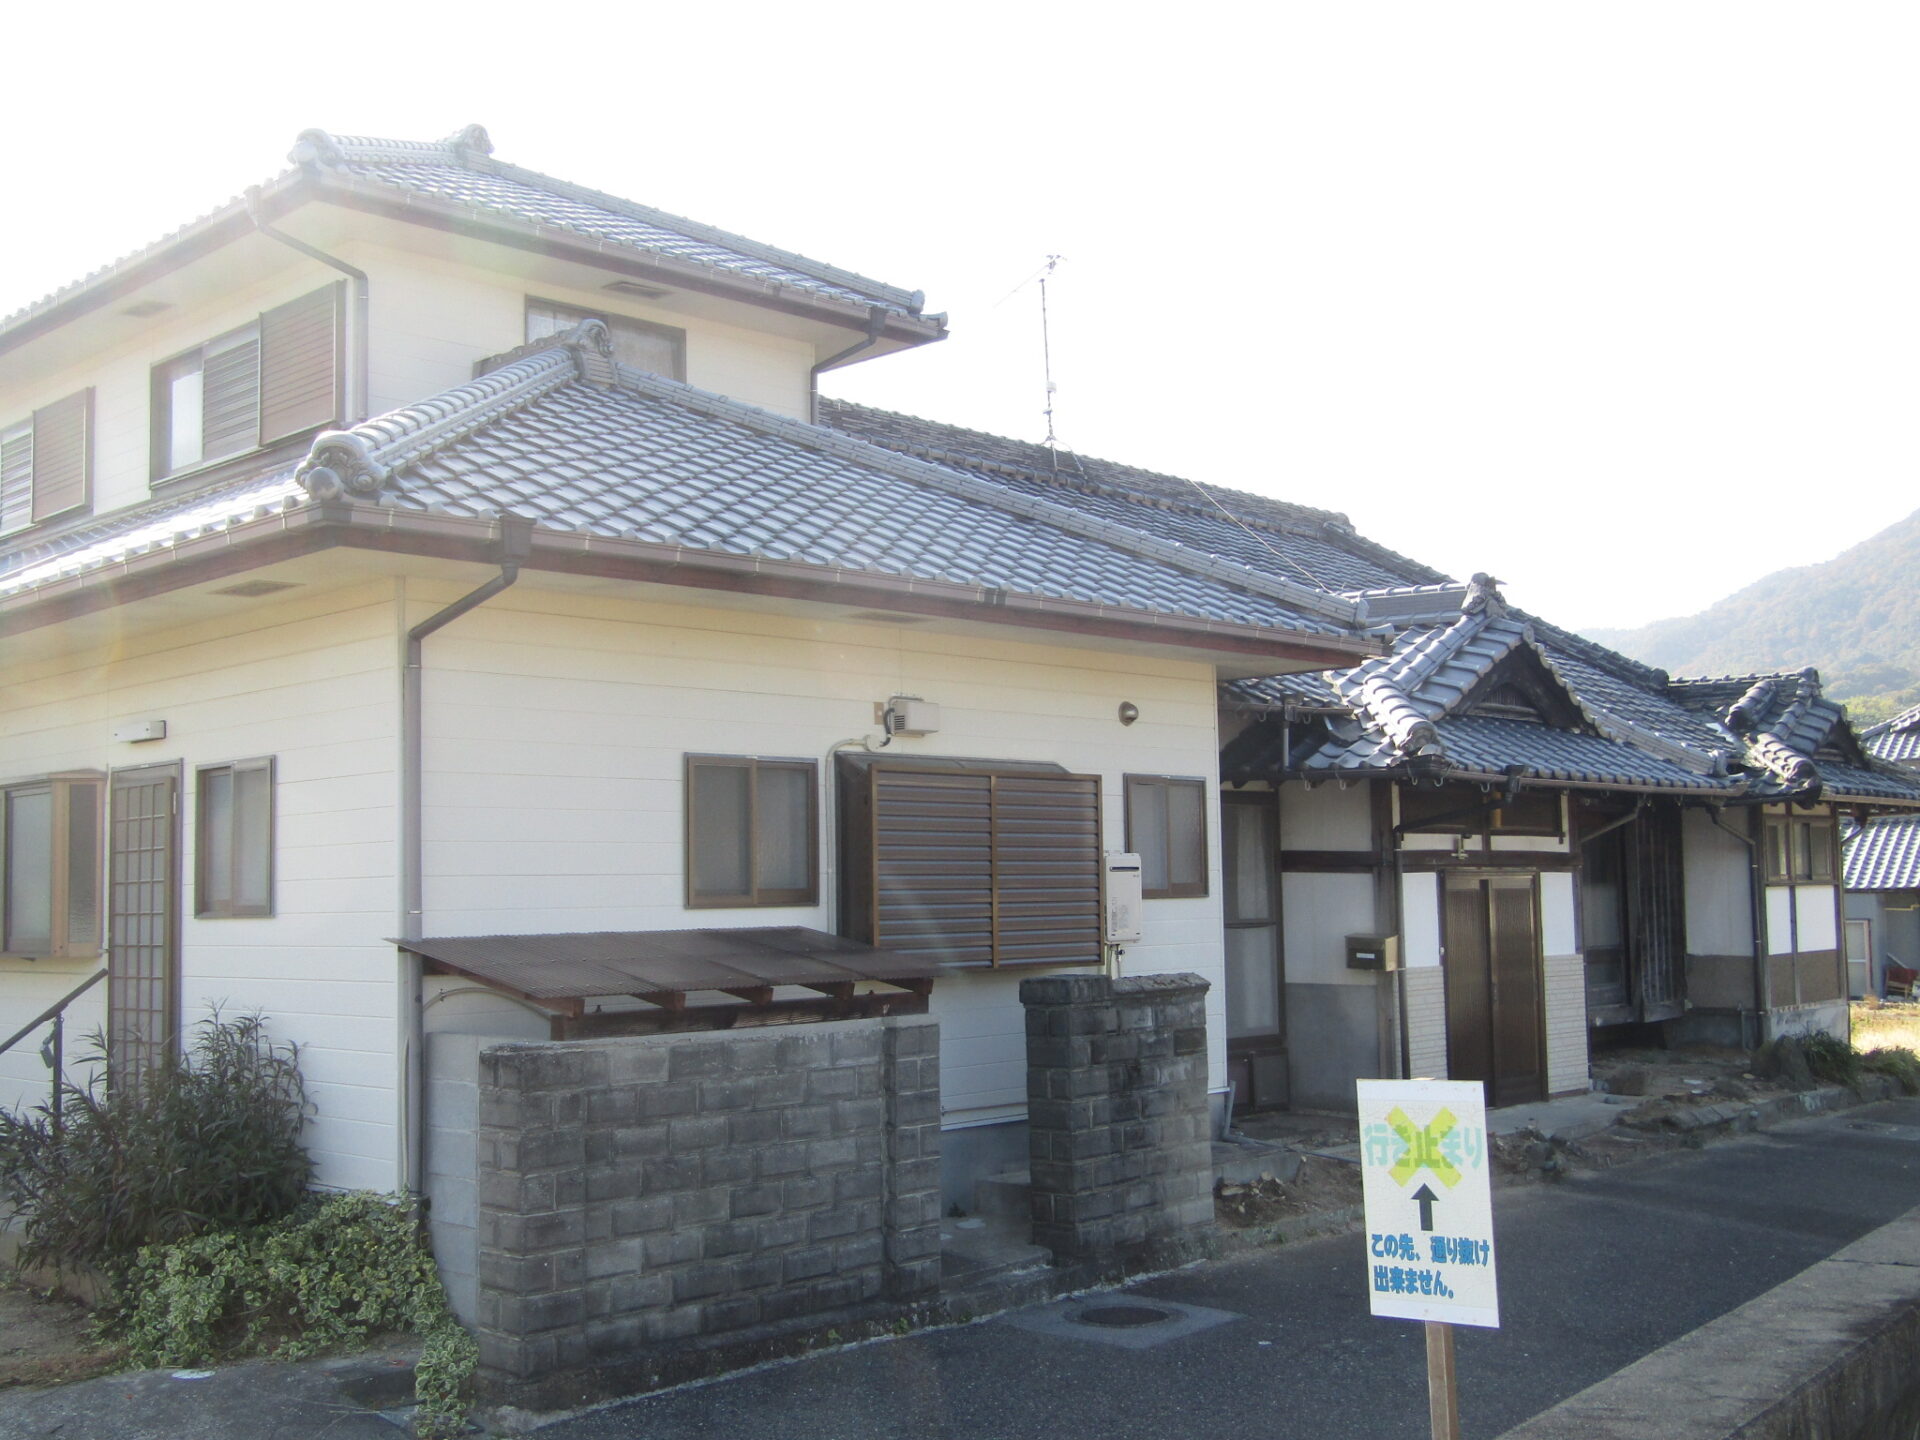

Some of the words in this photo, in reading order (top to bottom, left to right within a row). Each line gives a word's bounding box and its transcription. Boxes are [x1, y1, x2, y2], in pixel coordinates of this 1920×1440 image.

[1364, 1123, 1483, 1169] 行き止まり
[1373, 1264, 1454, 1299] 出来ません。
